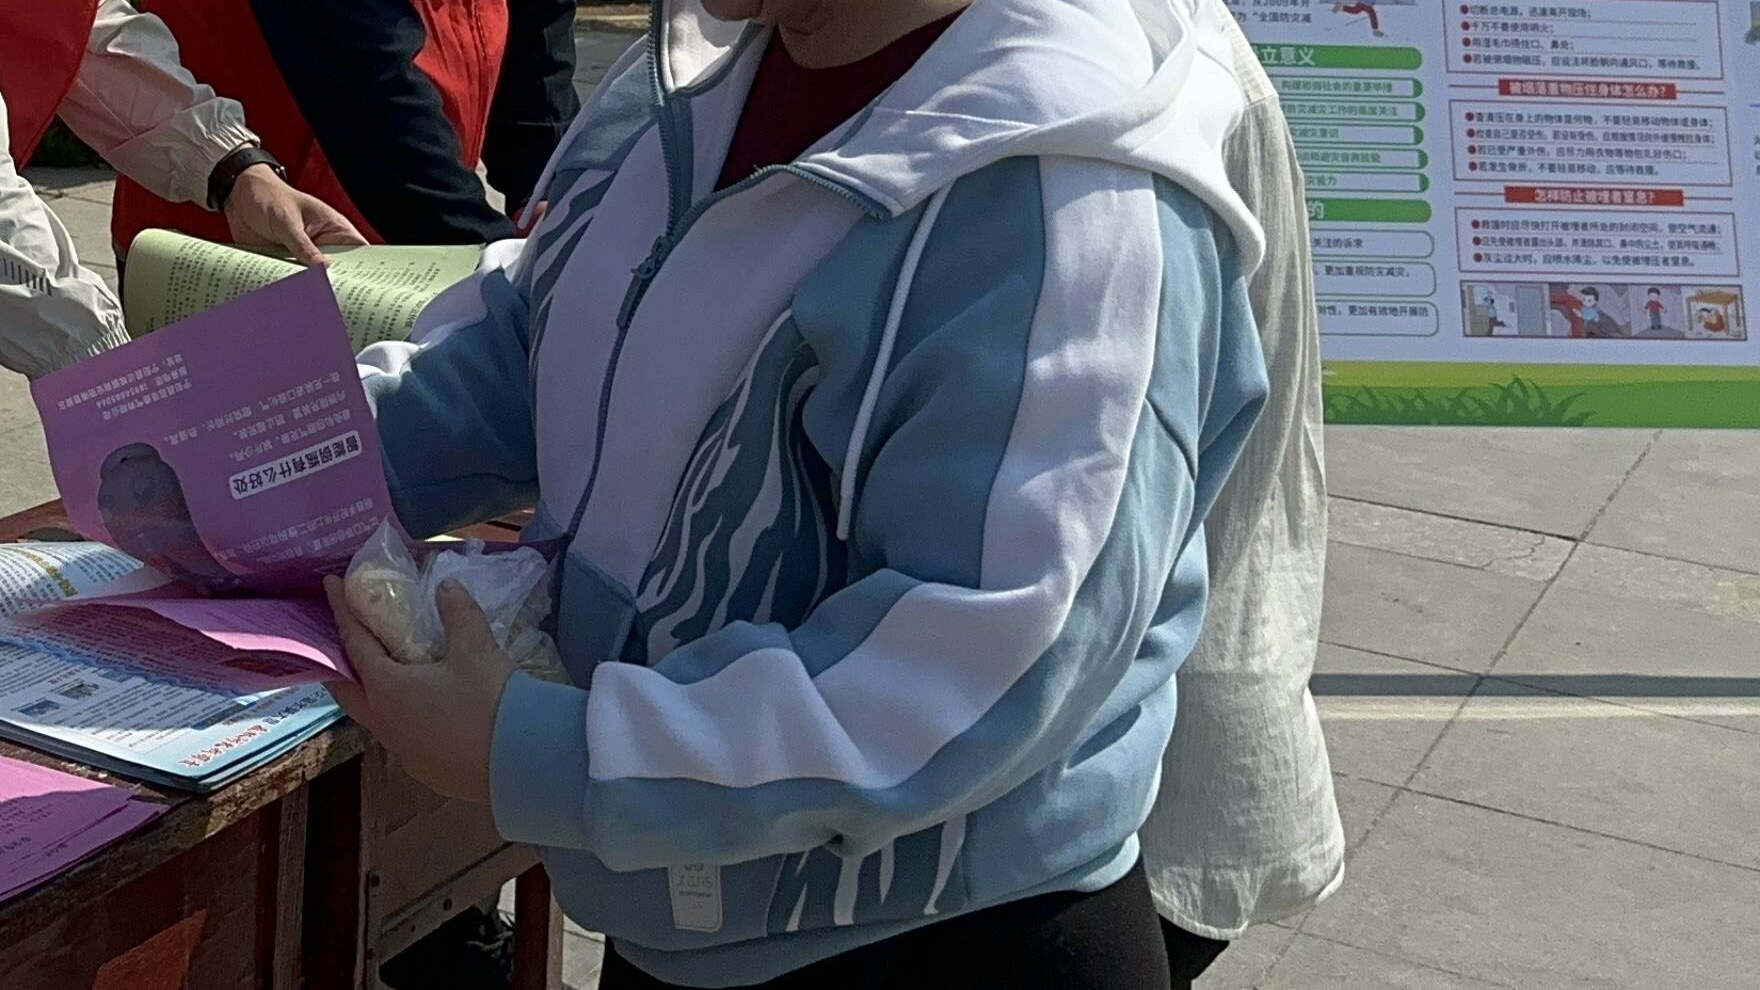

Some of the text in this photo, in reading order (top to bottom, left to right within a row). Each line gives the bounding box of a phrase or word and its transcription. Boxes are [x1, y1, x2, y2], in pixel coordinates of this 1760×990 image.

[1253, 45, 1317, 67] 立意义
[232, 433, 361, 496] 智能钢瓶有什么好处
